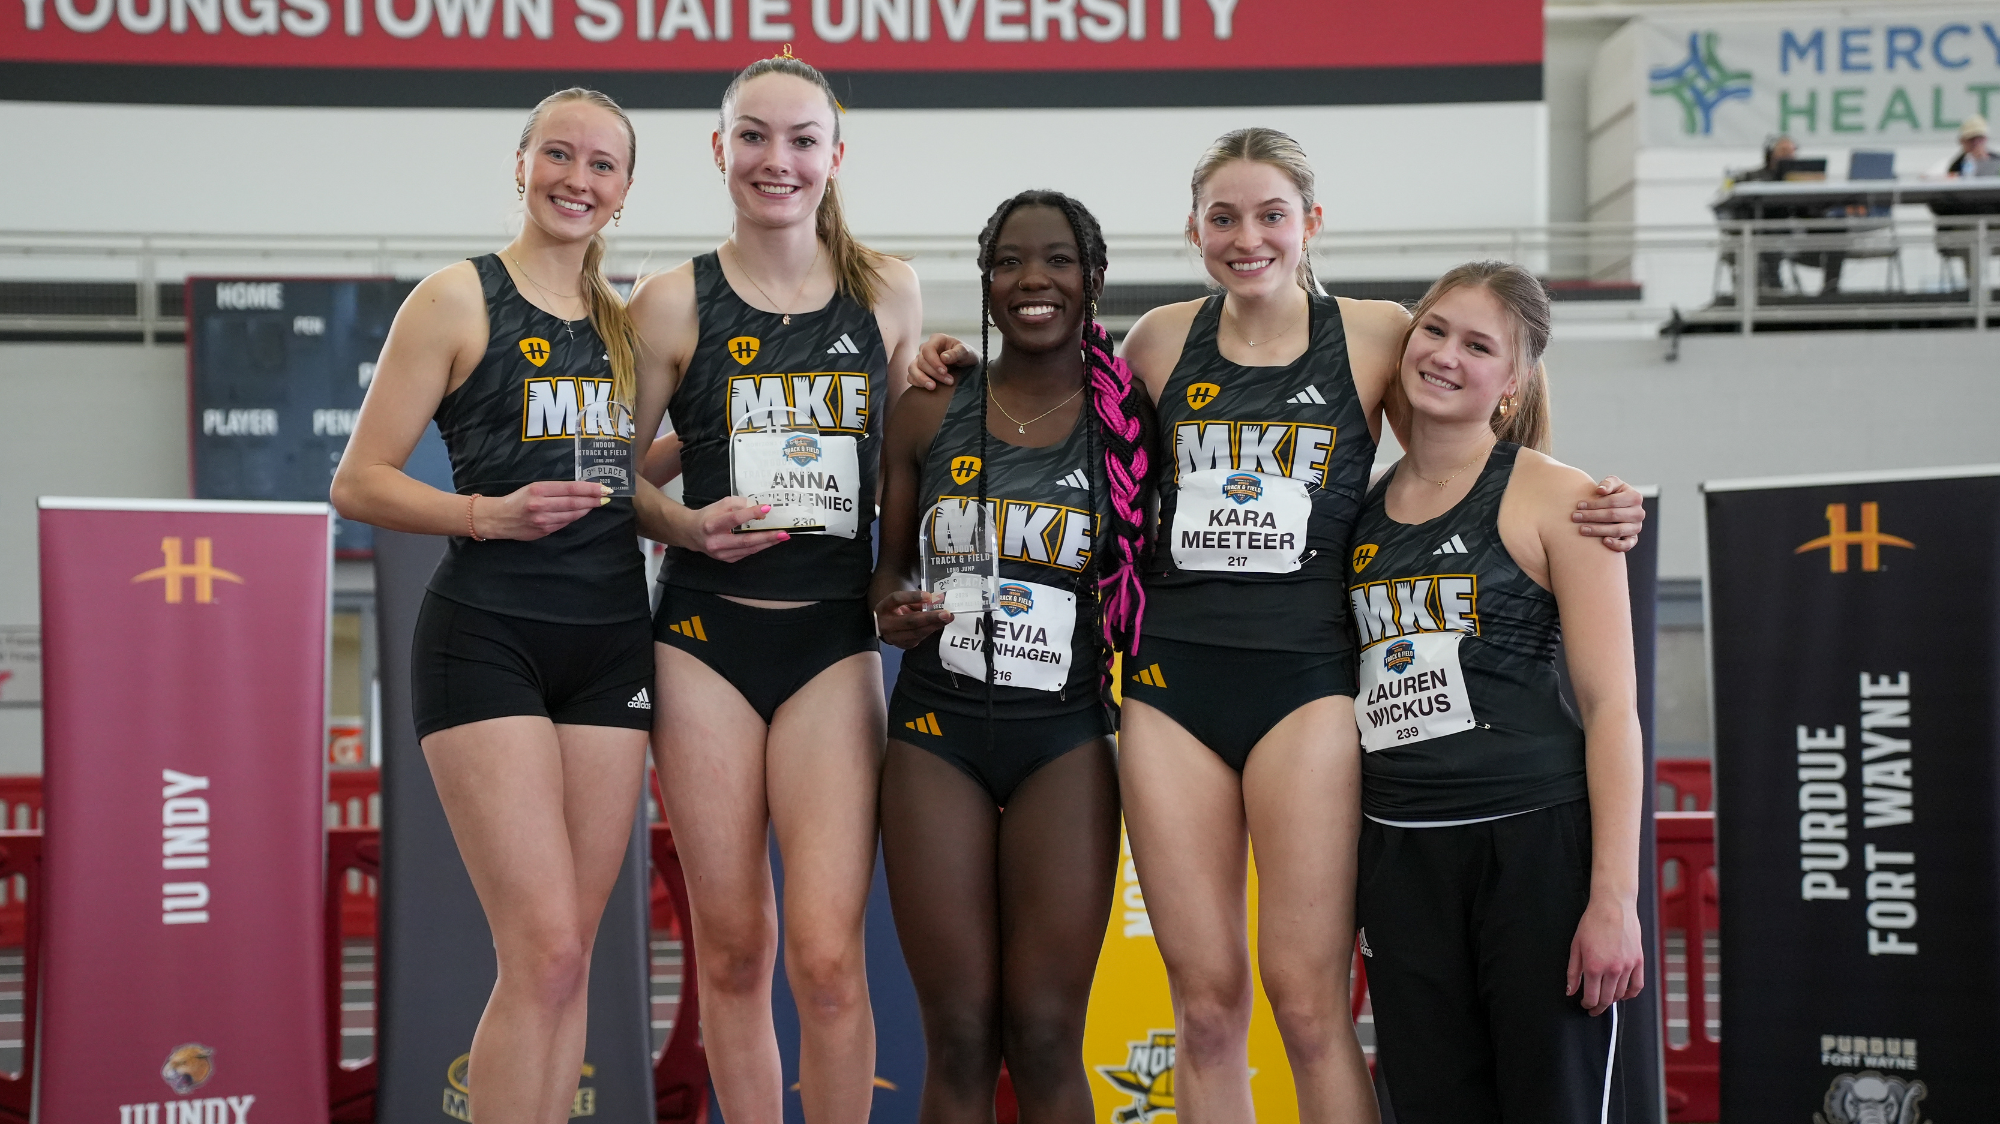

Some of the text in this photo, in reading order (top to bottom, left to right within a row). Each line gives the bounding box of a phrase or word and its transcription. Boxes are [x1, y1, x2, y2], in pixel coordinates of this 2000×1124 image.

[811, 0, 1240, 42] UNIVERSITY
[216, 281, 284, 311] HOME
[727, 372, 870, 436] MKE
[202, 408, 279, 437] PLAYER
[1173, 420, 1337, 490] MKE
[598, 467, 623, 477] PLACE
[770, 471, 840, 493] ANNA
[1208, 508, 1278, 530] KARA
[932, 496, 1101, 573] MKE
[1181, 531, 1296, 550] MEETEER
[930, 553, 991, 567] TRACK & FIELD
[1227, 556, 1249, 567] 217
[1349, 574, 1480, 652] MKE
[974, 616, 1049, 647] NEVIA
[950, 635, 1062, 665] LEVNHAGEN
[992, 669, 1013, 682] 216
[1367, 668, 1449, 706] LAUREN
[627, 700, 652, 710] adidas
[1366, 694, 1452, 729] WICKUS
[1396, 726, 1420, 740] 239
[1797, 724, 1850, 901] PURDUE
[1859, 671, 1919, 956] FORT WAYNE
[162, 768, 210, 925] IU INDY
[1820, 1034, 1917, 1056] PURDUE
[1821, 1052, 1918, 1071] FORT WAYNE
